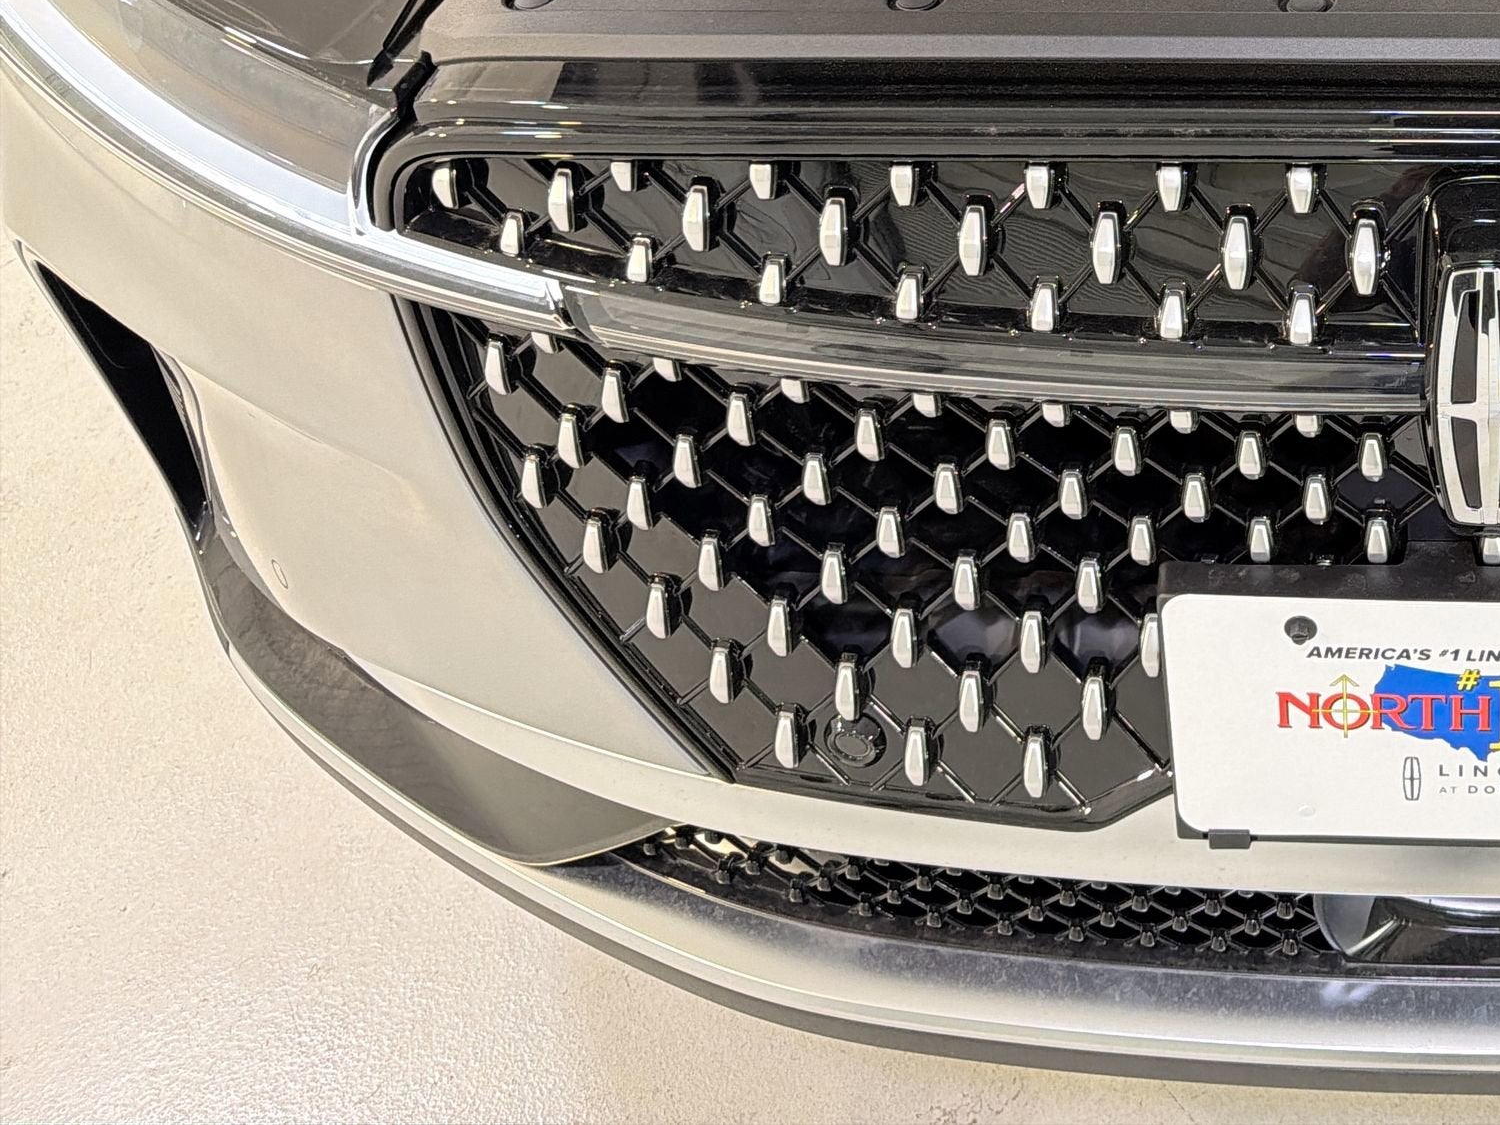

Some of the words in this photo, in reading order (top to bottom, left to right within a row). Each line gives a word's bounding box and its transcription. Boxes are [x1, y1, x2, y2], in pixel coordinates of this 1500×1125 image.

[1306, 645, 1432, 661] AMERICA'S
[1438, 649, 1460, 662] #1
[1275, 691, 1492, 732] NORTH
[1438, 786, 1457, 794] AT
